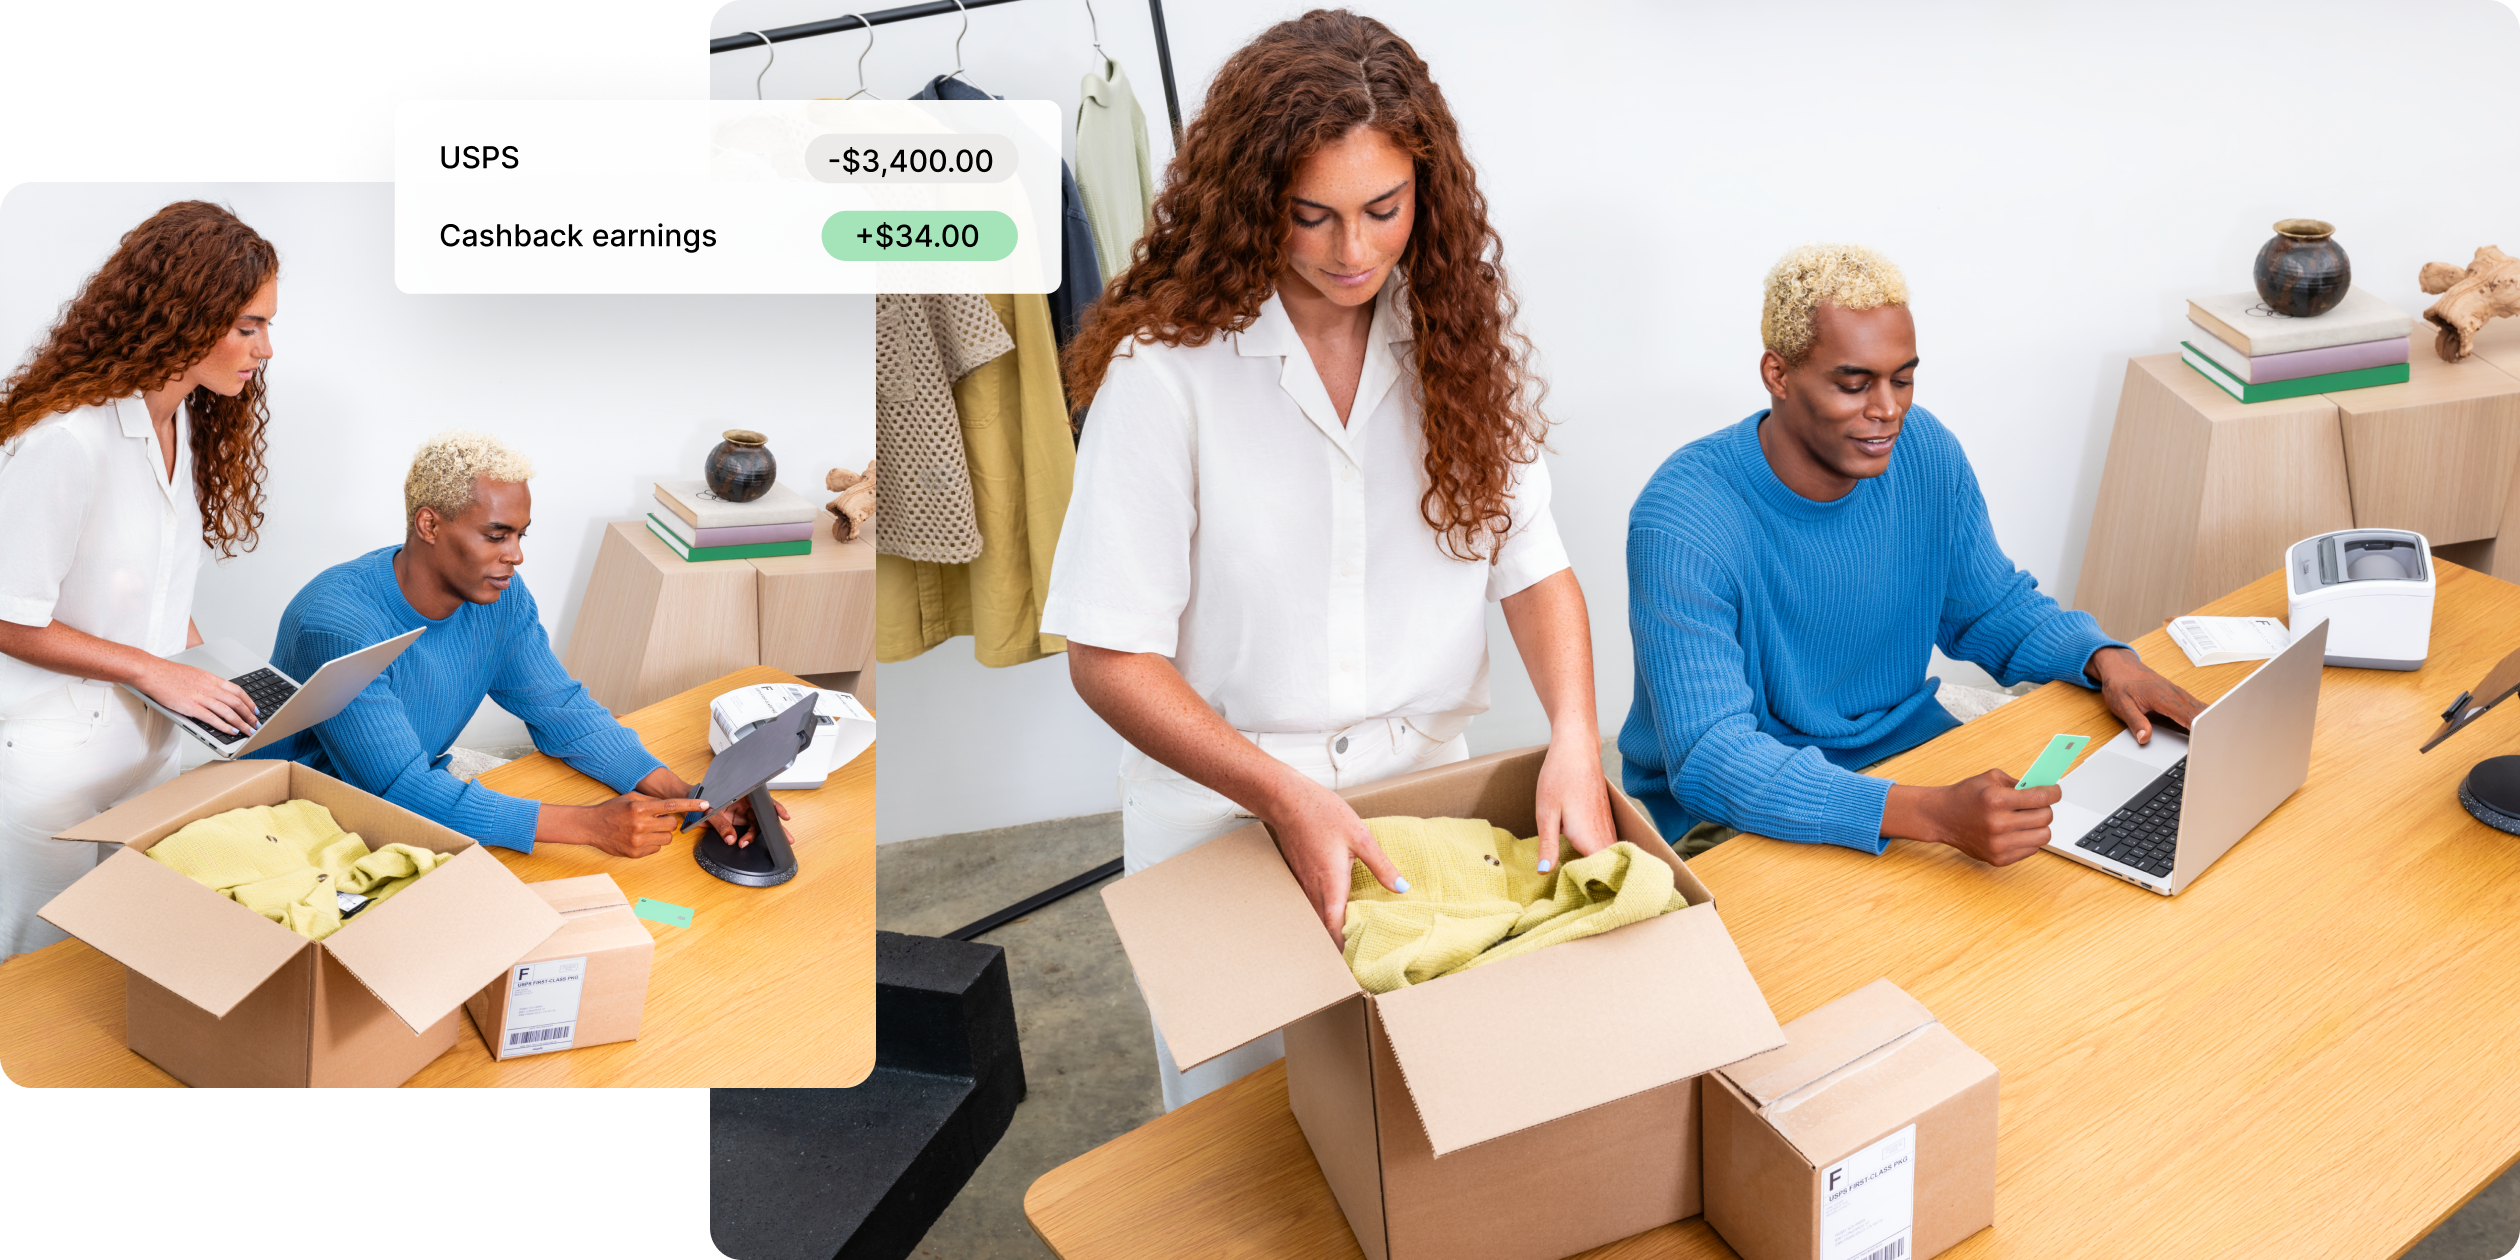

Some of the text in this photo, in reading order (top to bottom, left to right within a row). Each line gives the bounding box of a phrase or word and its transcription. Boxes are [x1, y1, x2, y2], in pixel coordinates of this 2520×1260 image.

[519, 968, 530, 981] F
[1828, 1155, 1908, 1202] USPS FIRST-CLASS PKG
[1829, 1167, 1842, 1191] F
